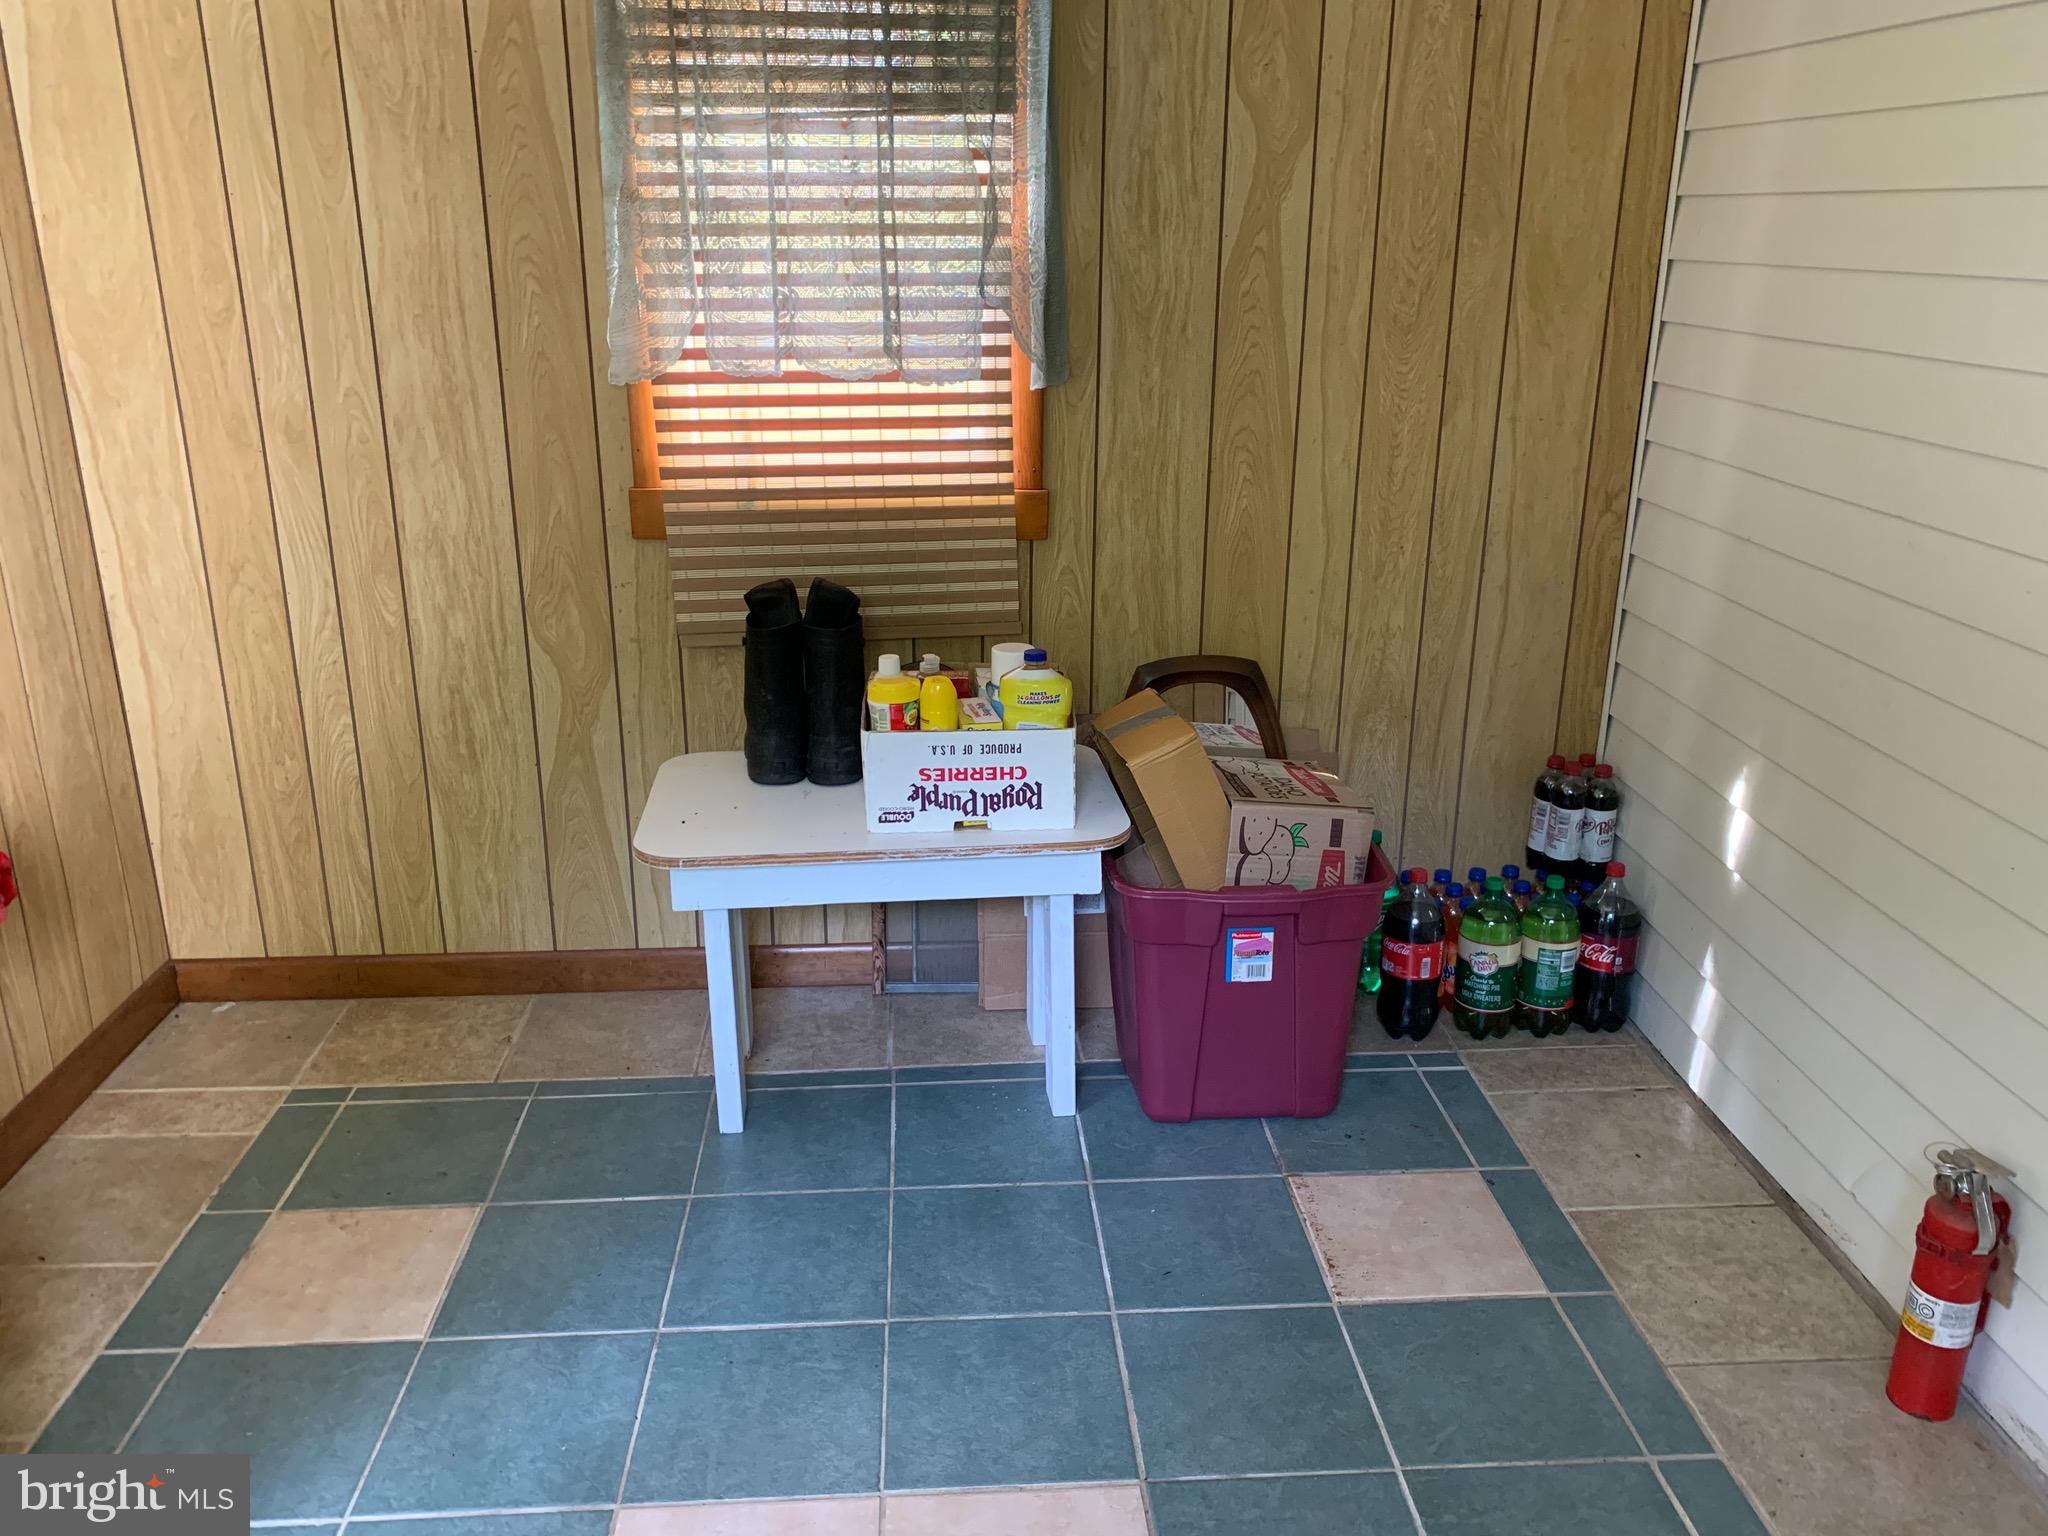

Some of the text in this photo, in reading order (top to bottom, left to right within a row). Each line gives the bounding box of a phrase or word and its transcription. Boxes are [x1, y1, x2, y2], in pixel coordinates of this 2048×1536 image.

[928, 743, 1022, 756] PRODUCE OF U.S.A.
[918, 765, 1028, 782] CHERRIES
[907, 781, 1043, 817] Royal Purple
[880, 813, 912, 821] DOUBLE
